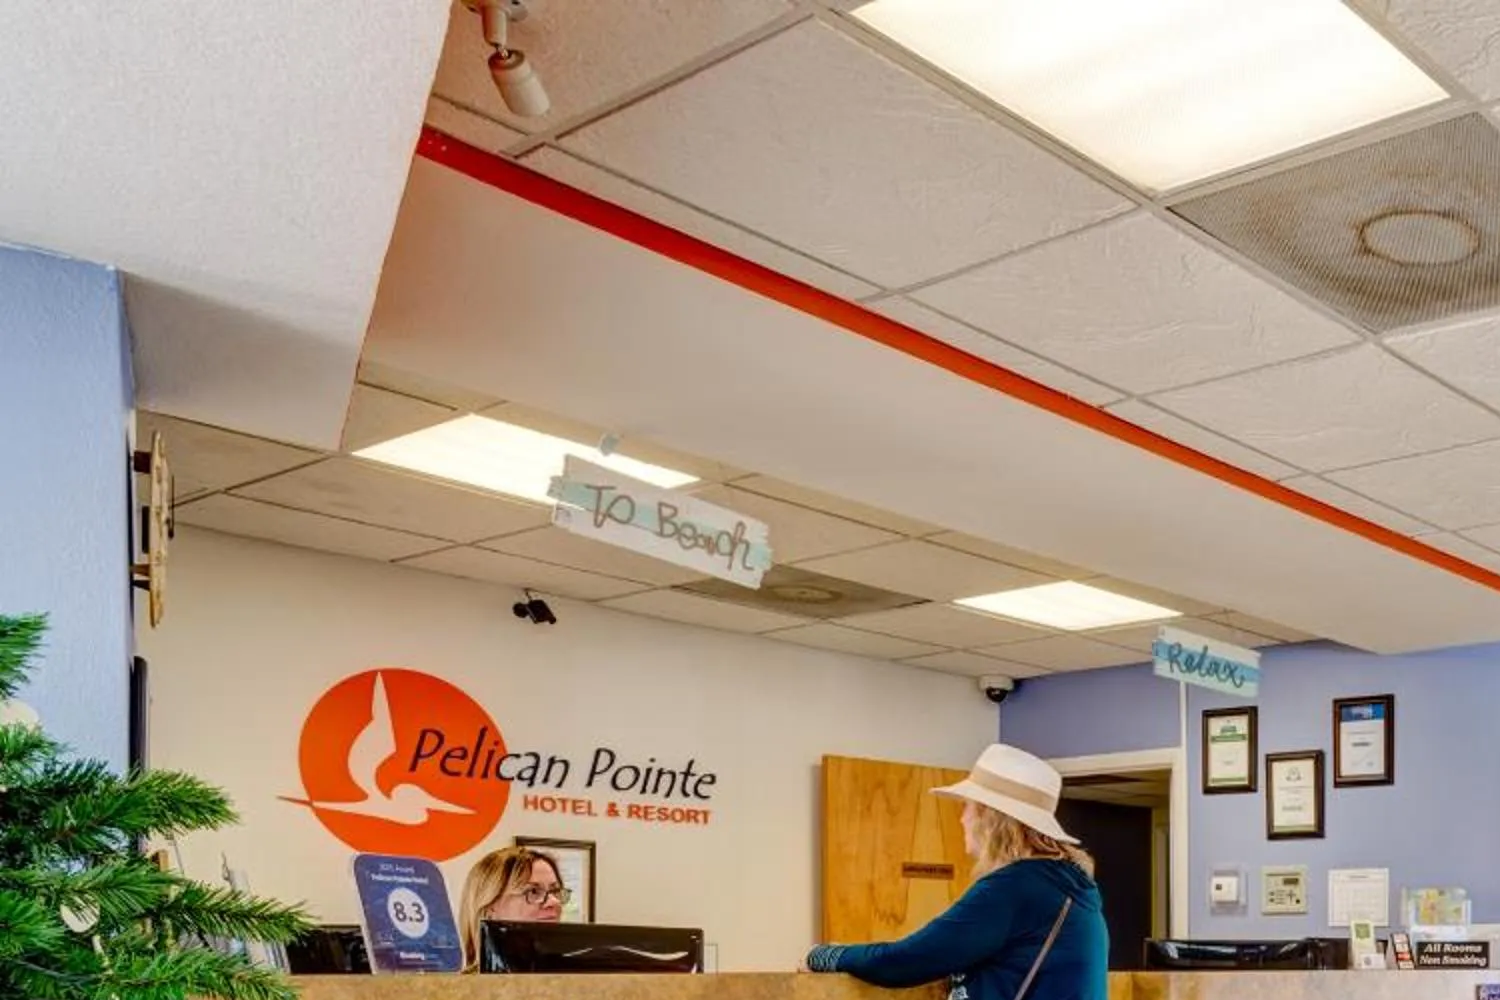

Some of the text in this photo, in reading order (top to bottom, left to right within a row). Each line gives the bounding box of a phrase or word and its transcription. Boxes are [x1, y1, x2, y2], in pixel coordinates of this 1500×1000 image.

[657, 501, 755, 570] Beach
[1168, 642, 1245, 688] Relax
[408, 725, 717, 799] Pelican Pointe
[523, 794, 711, 824] HOTEL & RESORT
[393, 901, 425, 922] 8.3
[1423, 943, 1441, 953] All
